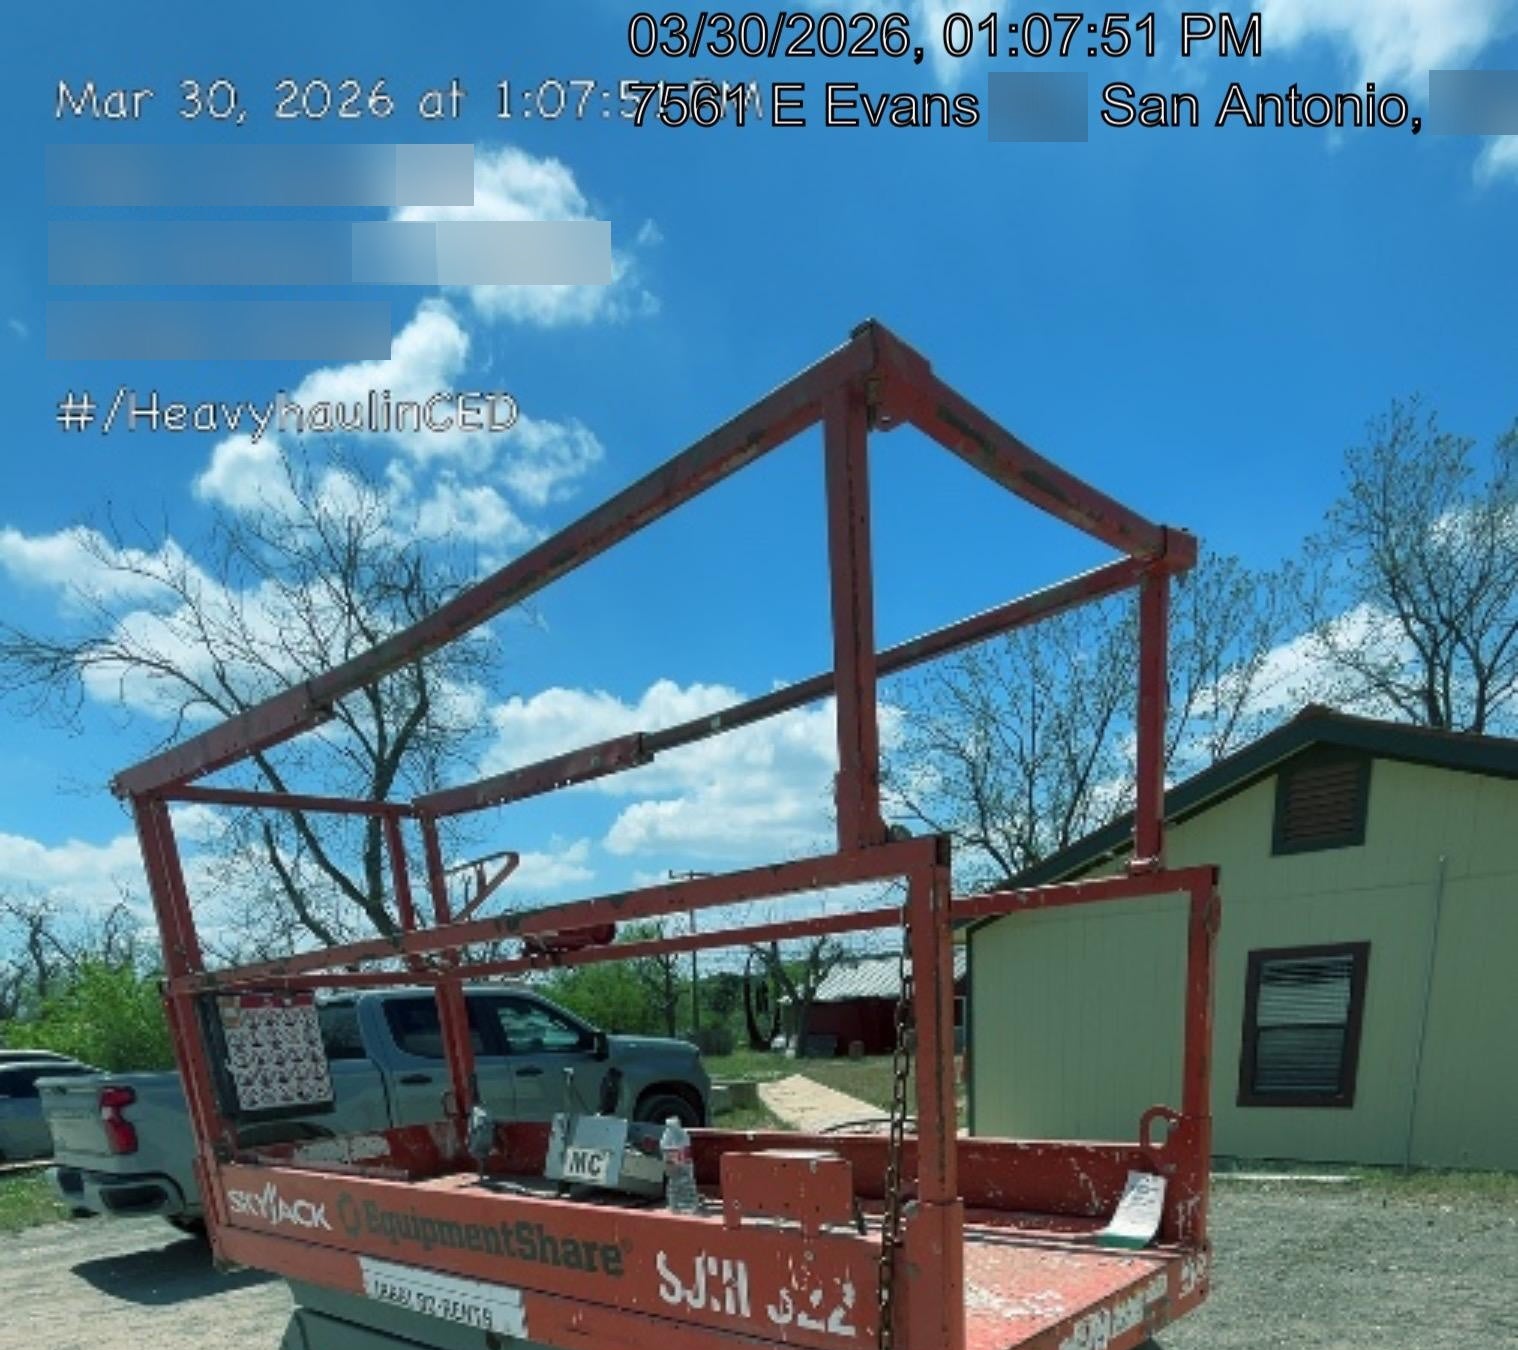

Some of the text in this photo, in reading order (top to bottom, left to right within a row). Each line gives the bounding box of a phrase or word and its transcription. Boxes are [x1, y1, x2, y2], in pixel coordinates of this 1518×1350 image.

[569, 1151, 604, 1176] MC
[227, 1181, 333, 1230] SKYJACK
[364, 1200, 625, 1277] EquipmentShare
